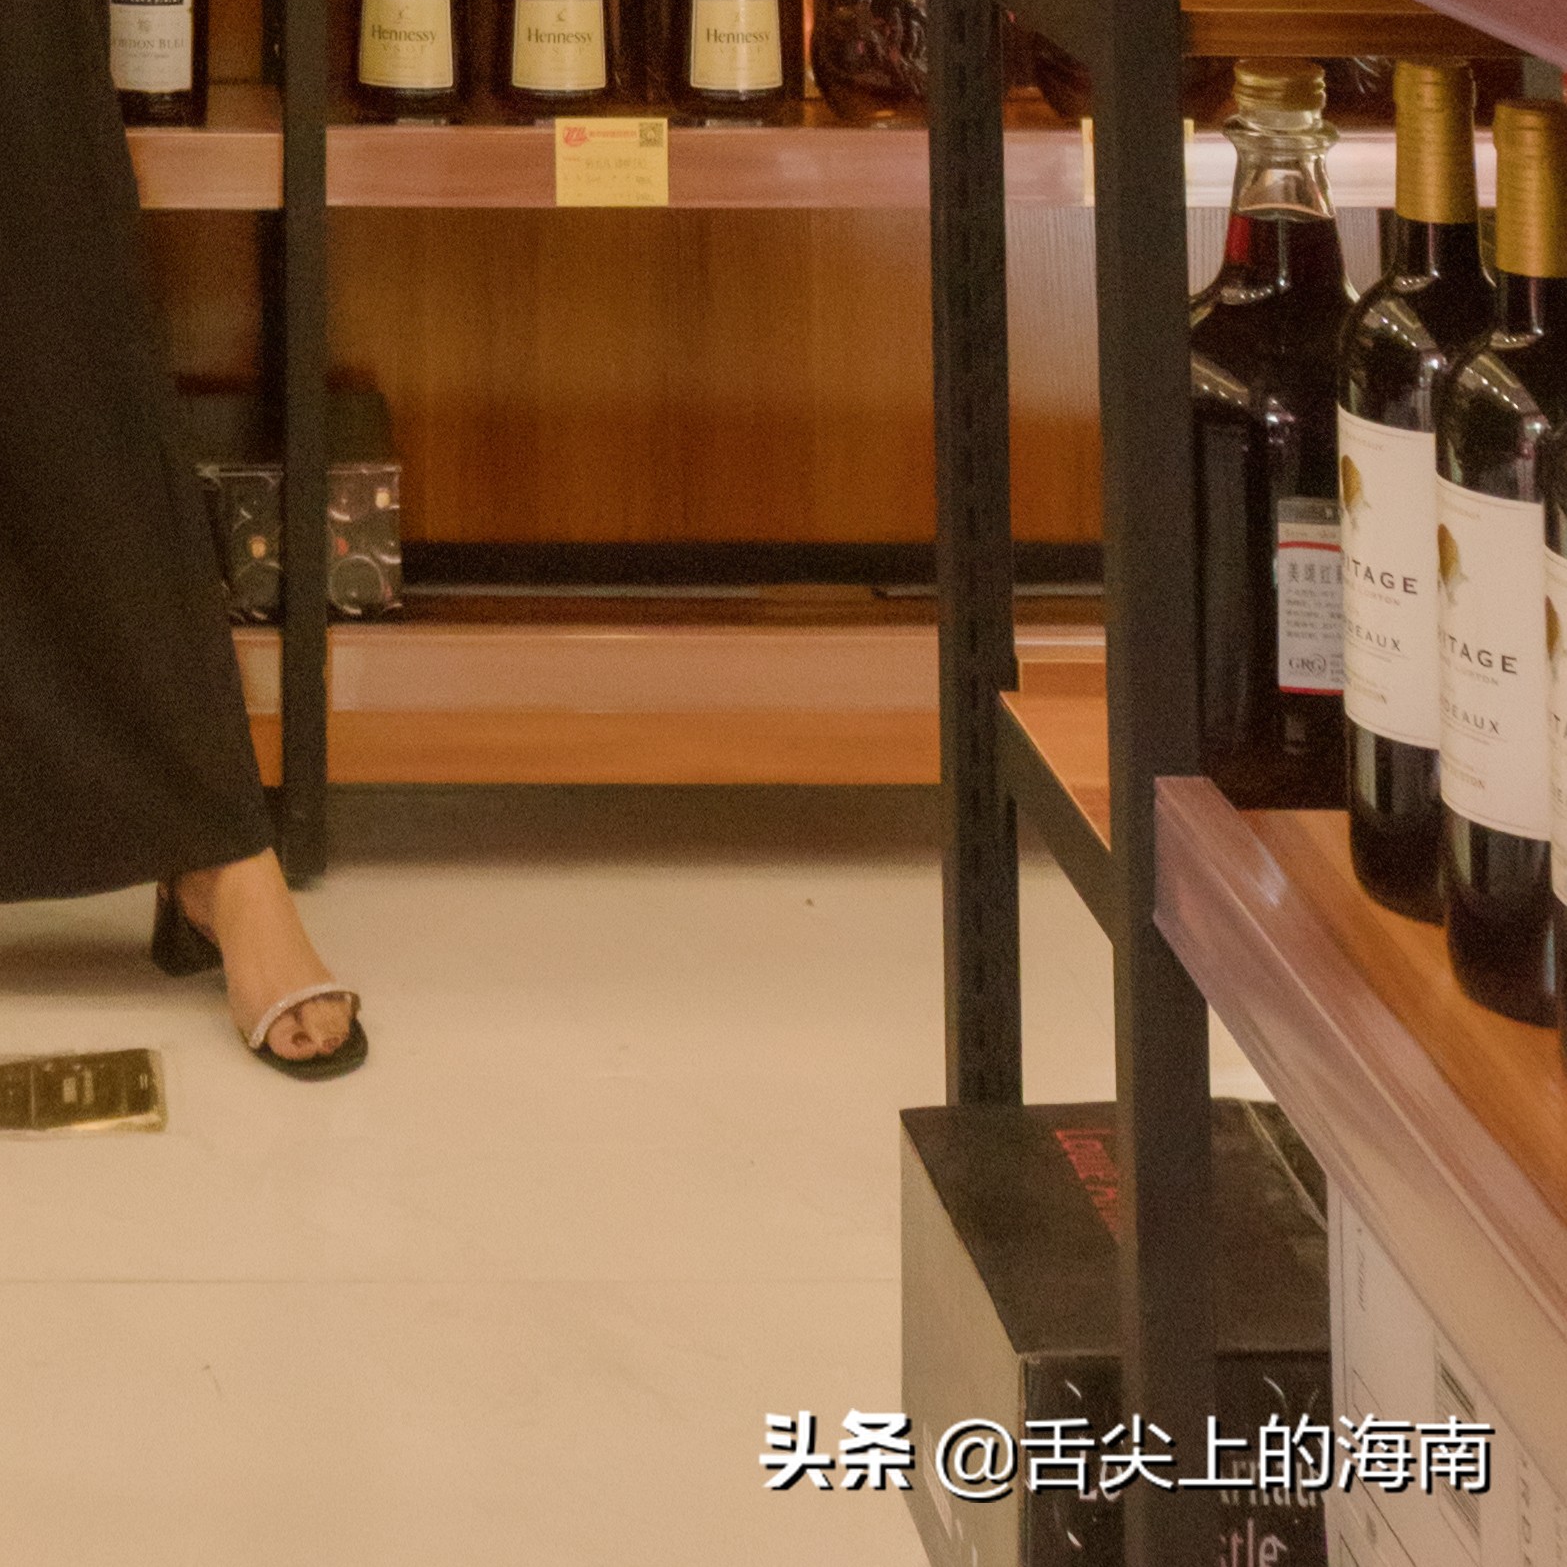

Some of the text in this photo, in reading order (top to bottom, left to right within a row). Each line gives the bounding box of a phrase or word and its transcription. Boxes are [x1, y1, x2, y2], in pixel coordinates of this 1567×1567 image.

[371, 24, 437, 45] Hennessy
[527, 26, 593, 45] Hennessy
[706, 27, 771, 45] Hennessy
